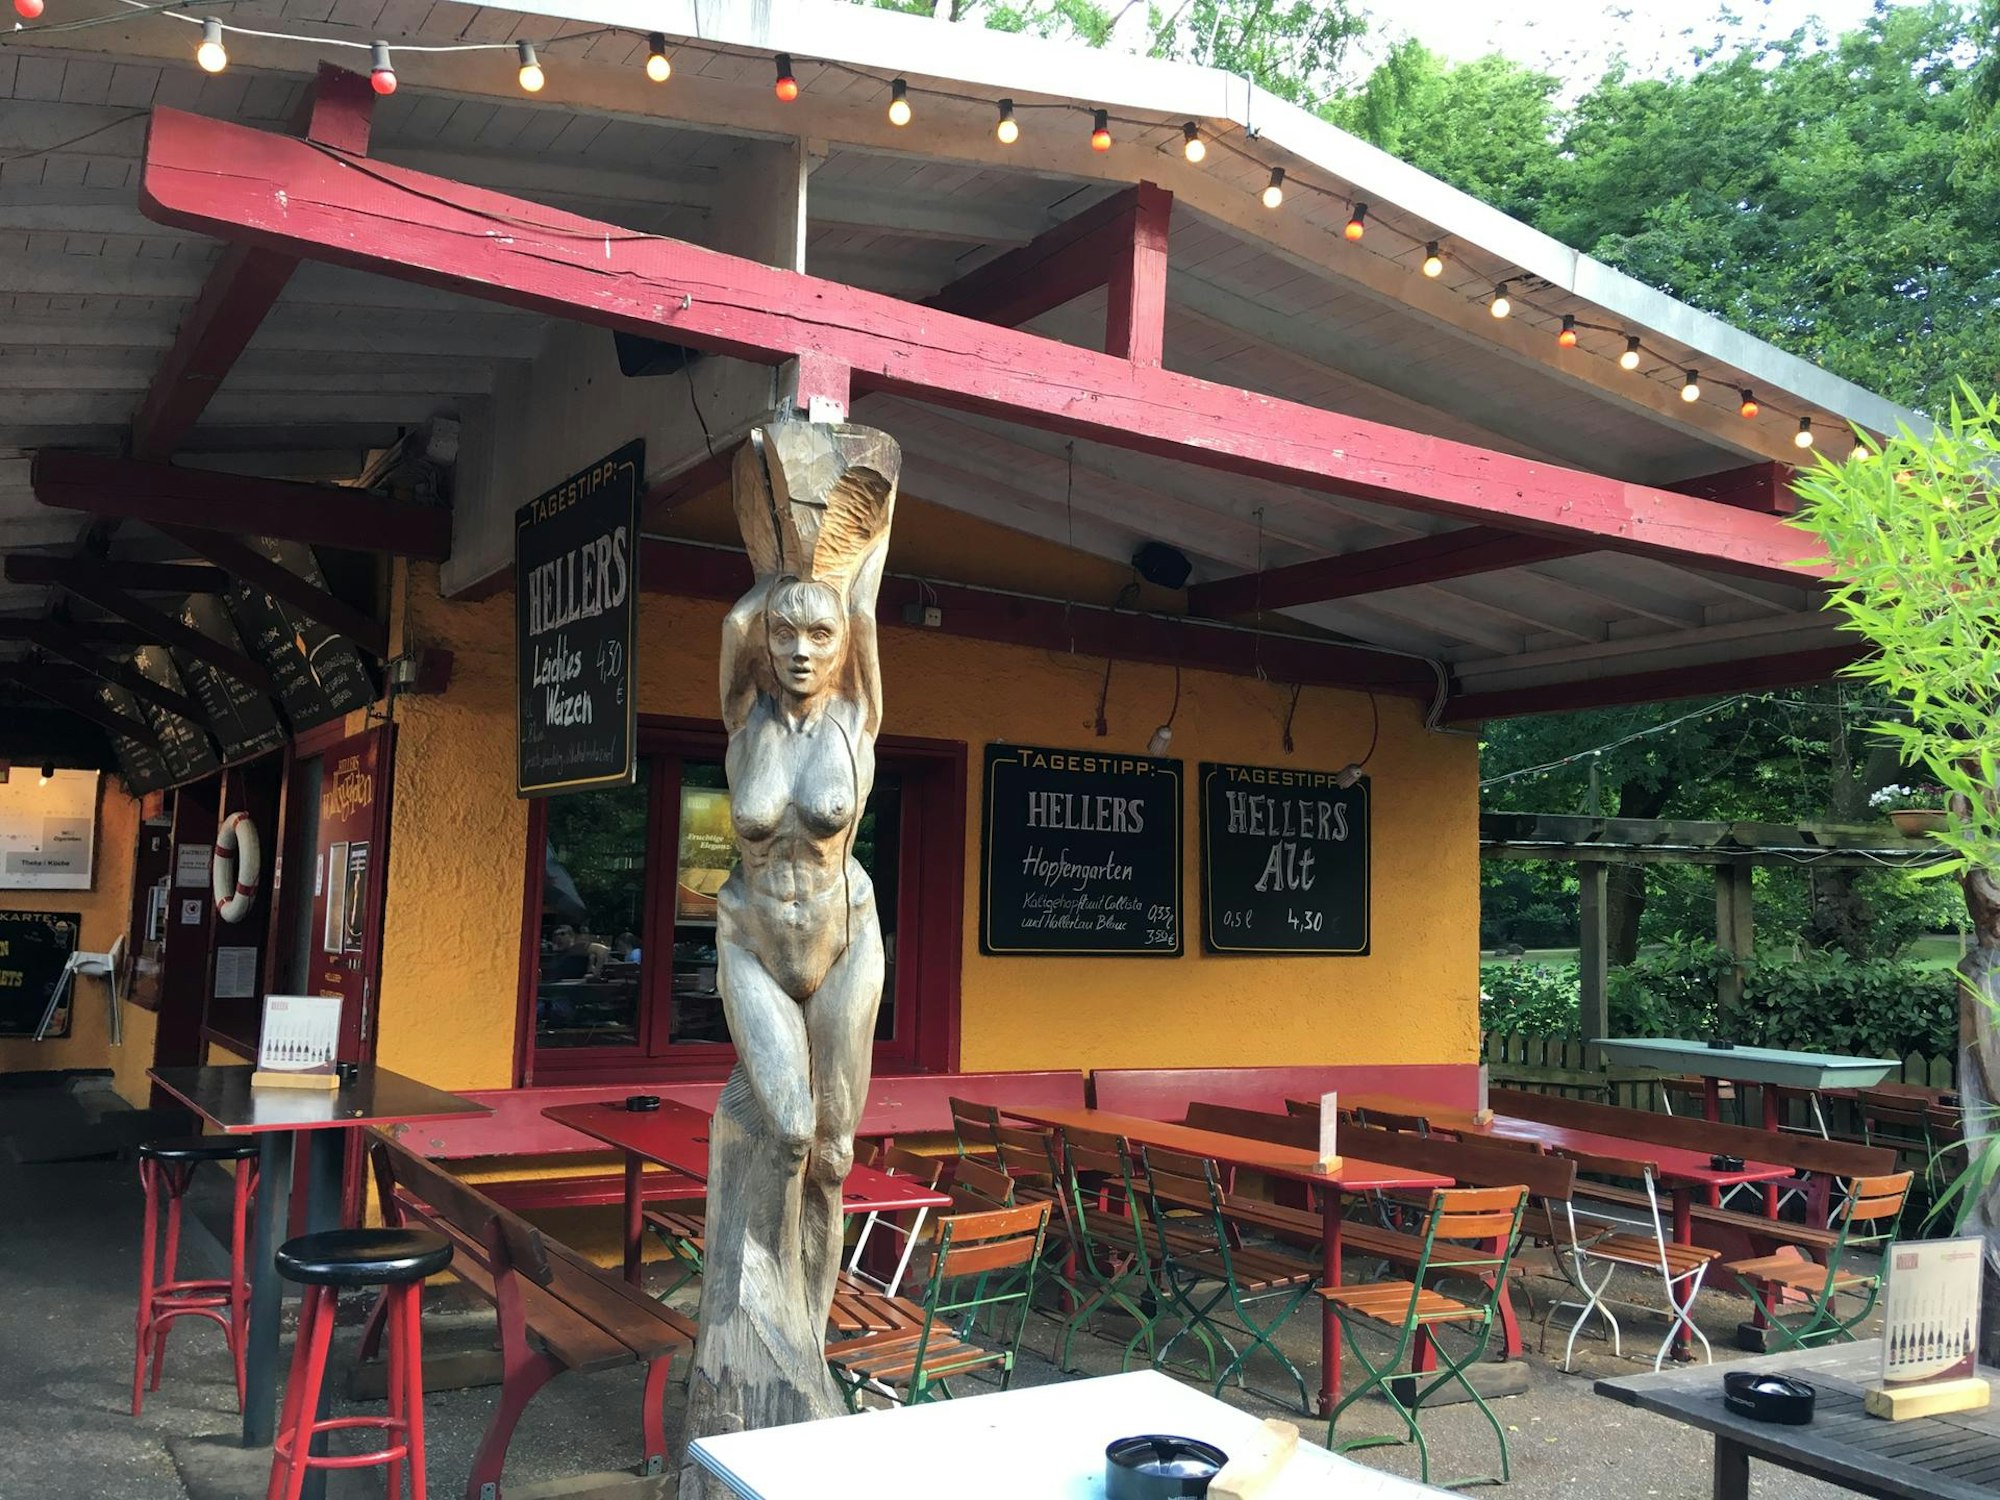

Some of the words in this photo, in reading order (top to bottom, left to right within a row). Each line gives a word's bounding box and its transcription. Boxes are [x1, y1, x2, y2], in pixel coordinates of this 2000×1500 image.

[530, 460, 618, 525] TAGESTIPP:
[528, 525, 627, 637] HELLERS
[532, 634, 582, 689] Leichtes
[596, 639, 623, 684] 4,30
[546, 684, 593, 727] Weizen
[1017, 749, 1155, 777] TAGESTIPP:
[1026, 790, 1145, 834] HELLERS
[1225, 790, 1349, 842] HELLERS
[687, 832, 725, 843] Fruchtige
[1021, 845, 1133, 891] Hopfengarten
[1254, 839, 1316, 892] Alt
[1021, 914, 1043, 929] und
[1223, 910, 1242, 928] 0,5
[1287, 907, 1323, 933] 4,30
